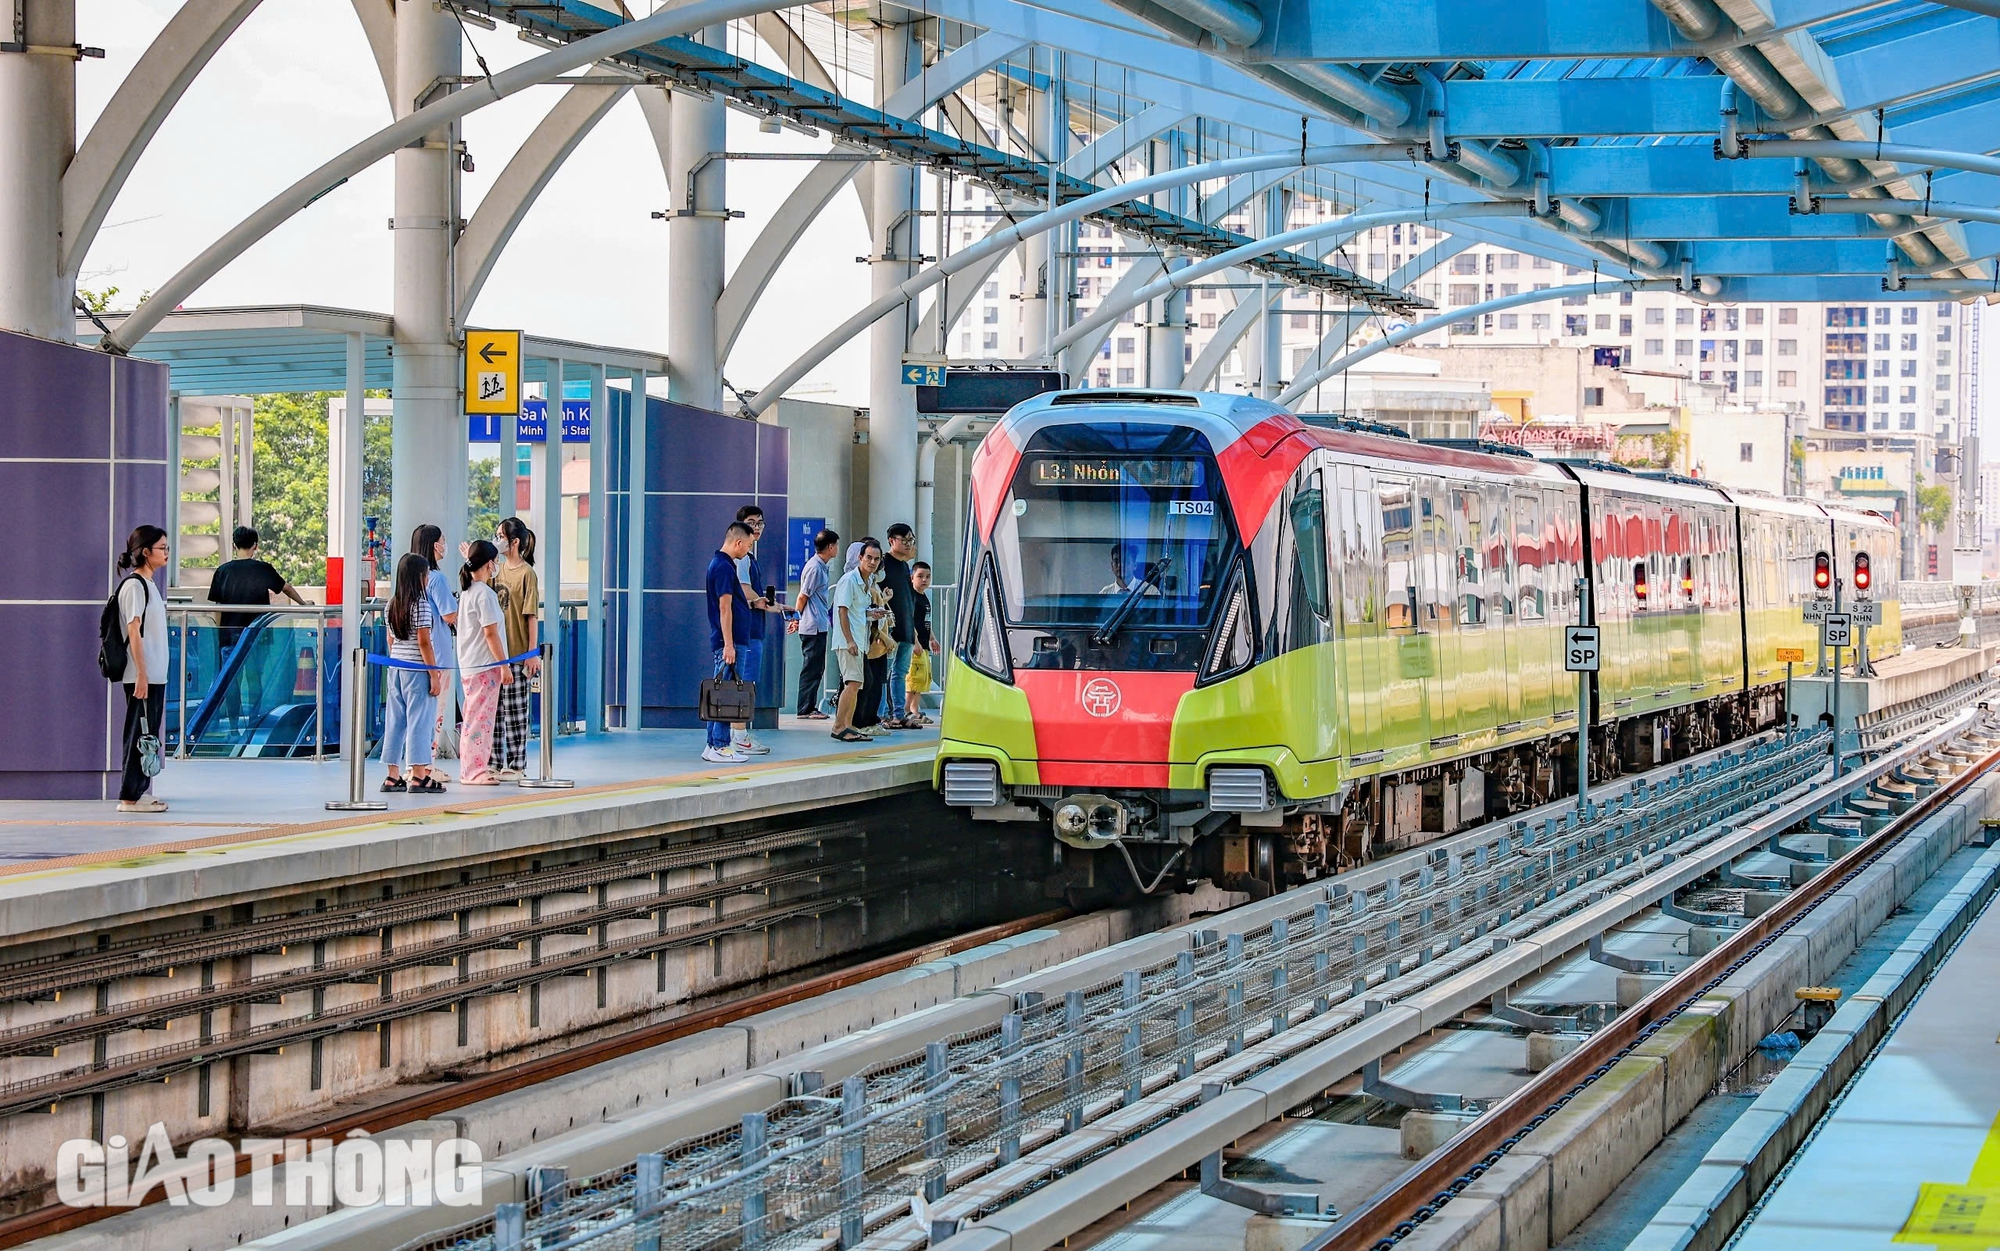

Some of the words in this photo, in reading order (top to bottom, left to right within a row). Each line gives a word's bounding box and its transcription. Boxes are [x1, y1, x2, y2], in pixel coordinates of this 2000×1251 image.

[519, 408, 537, 421] Ga
[519, 425, 544, 436] Minh
[570, 425, 590, 436] Stat
[1039, 463, 1066, 480] L3:
[1175, 502, 1213, 514] TS04
[1828, 630, 1848, 641] SP
[1570, 649, 1596, 664] SP
